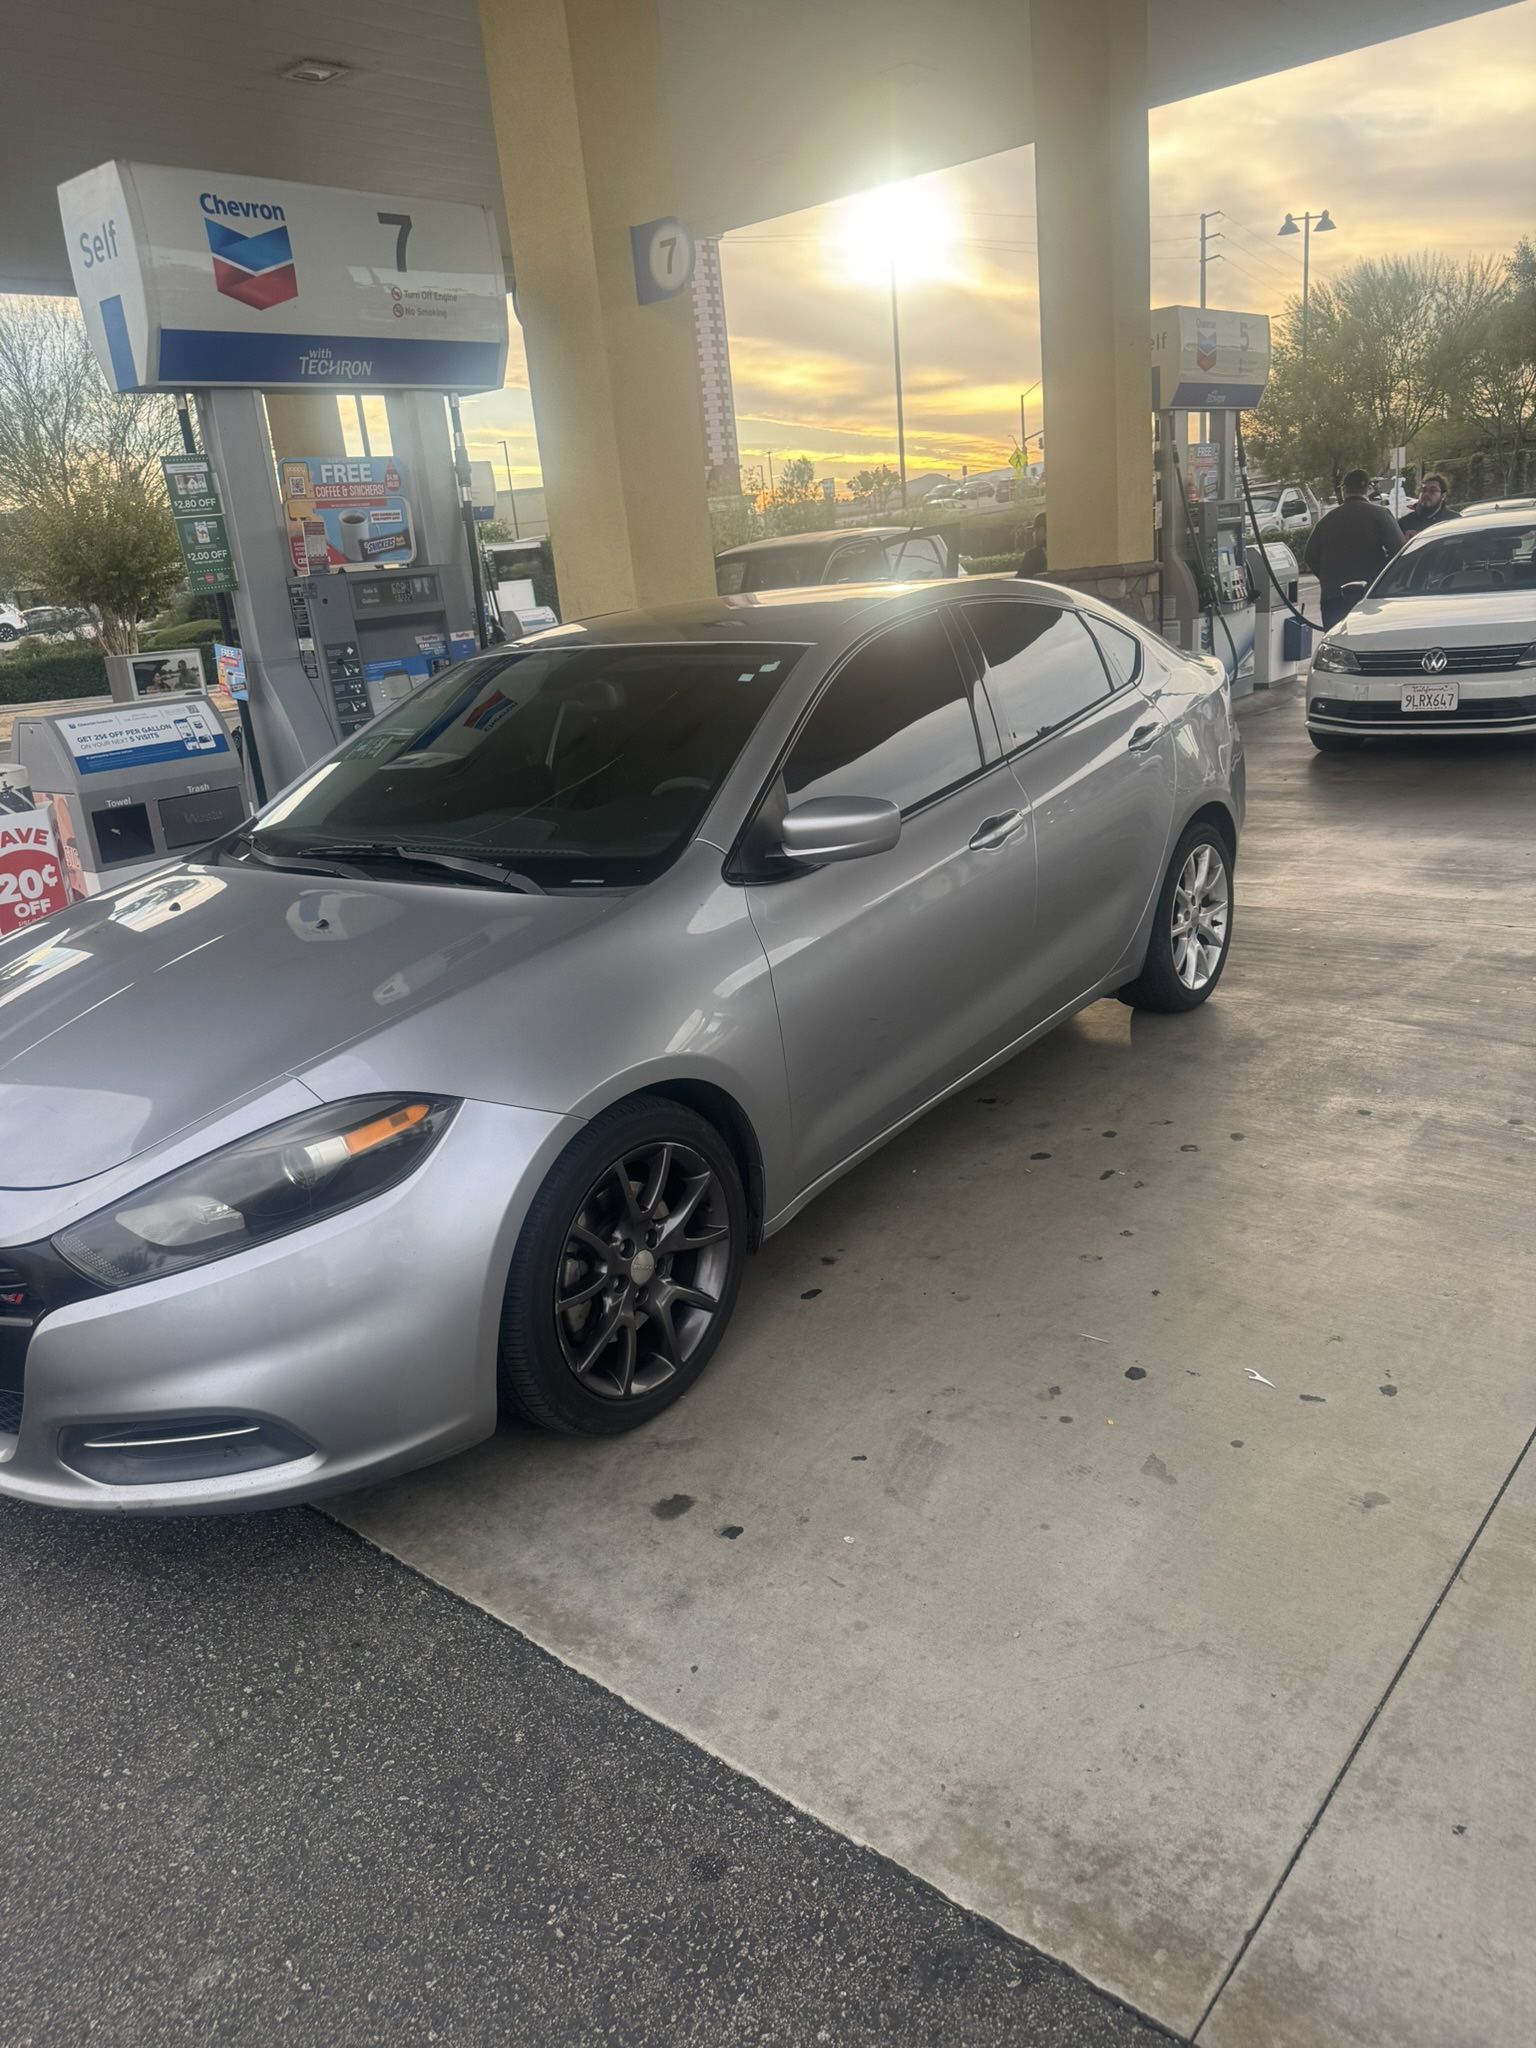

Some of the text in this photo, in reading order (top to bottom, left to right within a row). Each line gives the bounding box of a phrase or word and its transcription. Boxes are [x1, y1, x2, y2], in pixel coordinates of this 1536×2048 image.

[200, 193, 285, 221] Chevron
[79, 219, 118, 269] Self
[377, 212, 412, 272] 7
[659, 237, 676, 274] 7
[403, 289, 458, 303] Turn Off Engine
[405, 307, 448, 319] No Smoking
[1240, 322, 1250, 352] 5
[309, 347, 332, 359] with
[299, 356, 373, 379] TECHRON
[320, 463, 373, 483] FREE
[315, 485, 342, 498] COFFEE
[174, 498, 217, 509] $2.80 OFF
[187, 549, 228, 561] $2.00 OFF
[367, 537, 396, 554] SNICKERS
[1405, 693, 1455, 707] 9LRX647
[77, 734, 93, 744] GET
[108, 730, 125, 738] OFF
[125, 727, 140, 736] PER
[140, 723, 172, 734] GALLON
[80, 742, 93, 750] ON
[135, 732, 160, 742] VISITS
[186, 783, 210, 793] Trash
[106, 797, 132, 808] Towel
[0, 828, 49, 848] AVE
[0, 863, 58, 905] 20¢
[14, 898, 51, 918] OFF
